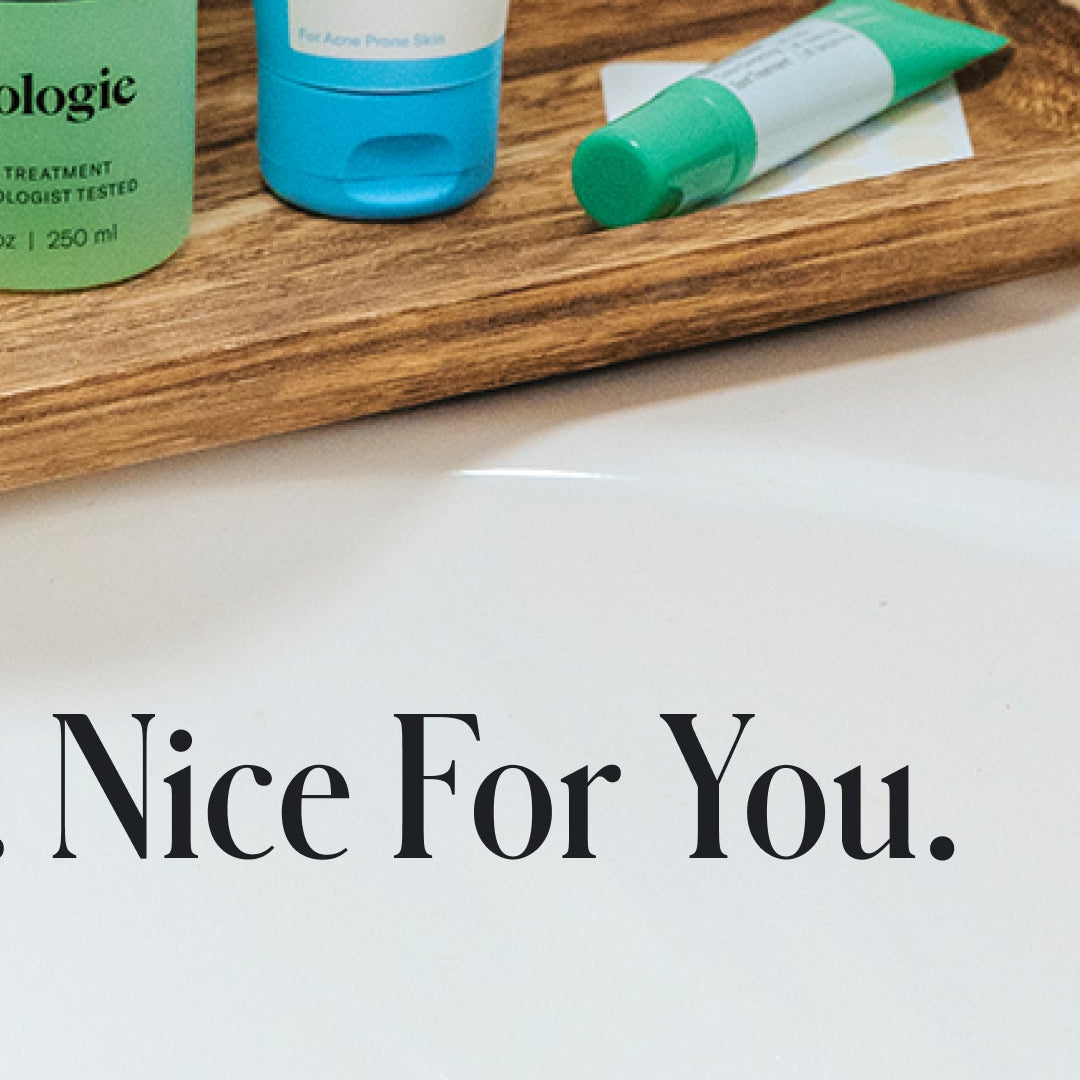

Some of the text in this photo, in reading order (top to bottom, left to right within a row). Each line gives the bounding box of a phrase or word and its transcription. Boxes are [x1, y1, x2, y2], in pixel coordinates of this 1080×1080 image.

[298, 27, 447, 48] For Acne Prone Skin
[3, 160, 113, 183] TREATMENT
[76, 177, 139, 203] TESTED
[46, 228, 89, 251] 250
[94, 222, 119, 245] ml
